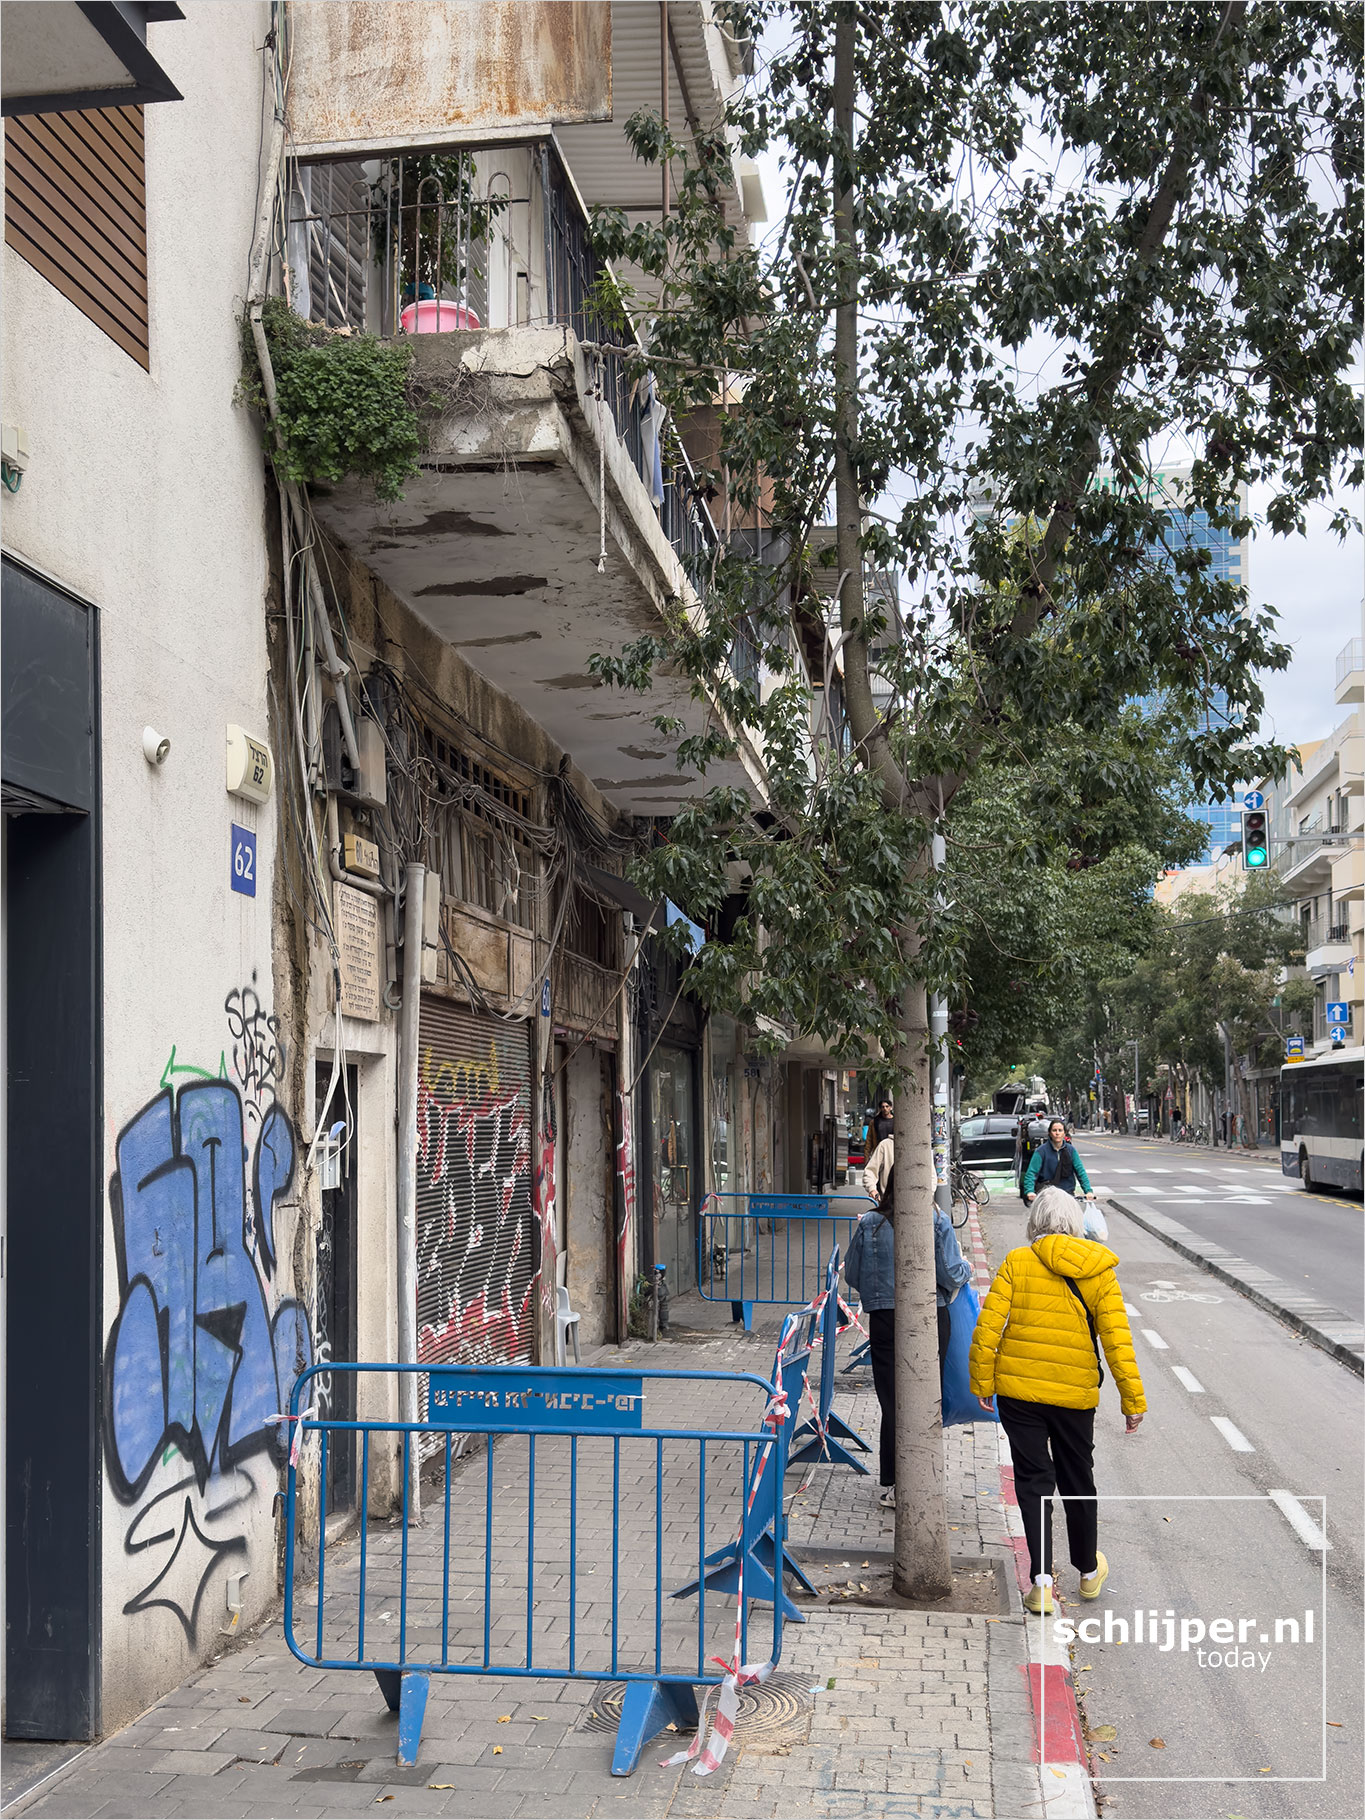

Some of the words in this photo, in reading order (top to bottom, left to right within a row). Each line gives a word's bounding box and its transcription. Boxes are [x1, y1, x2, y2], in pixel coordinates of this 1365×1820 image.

[249, 743, 268, 769] הרצל
[253, 766, 265, 785] 62
[234, 842, 254, 881] 62
